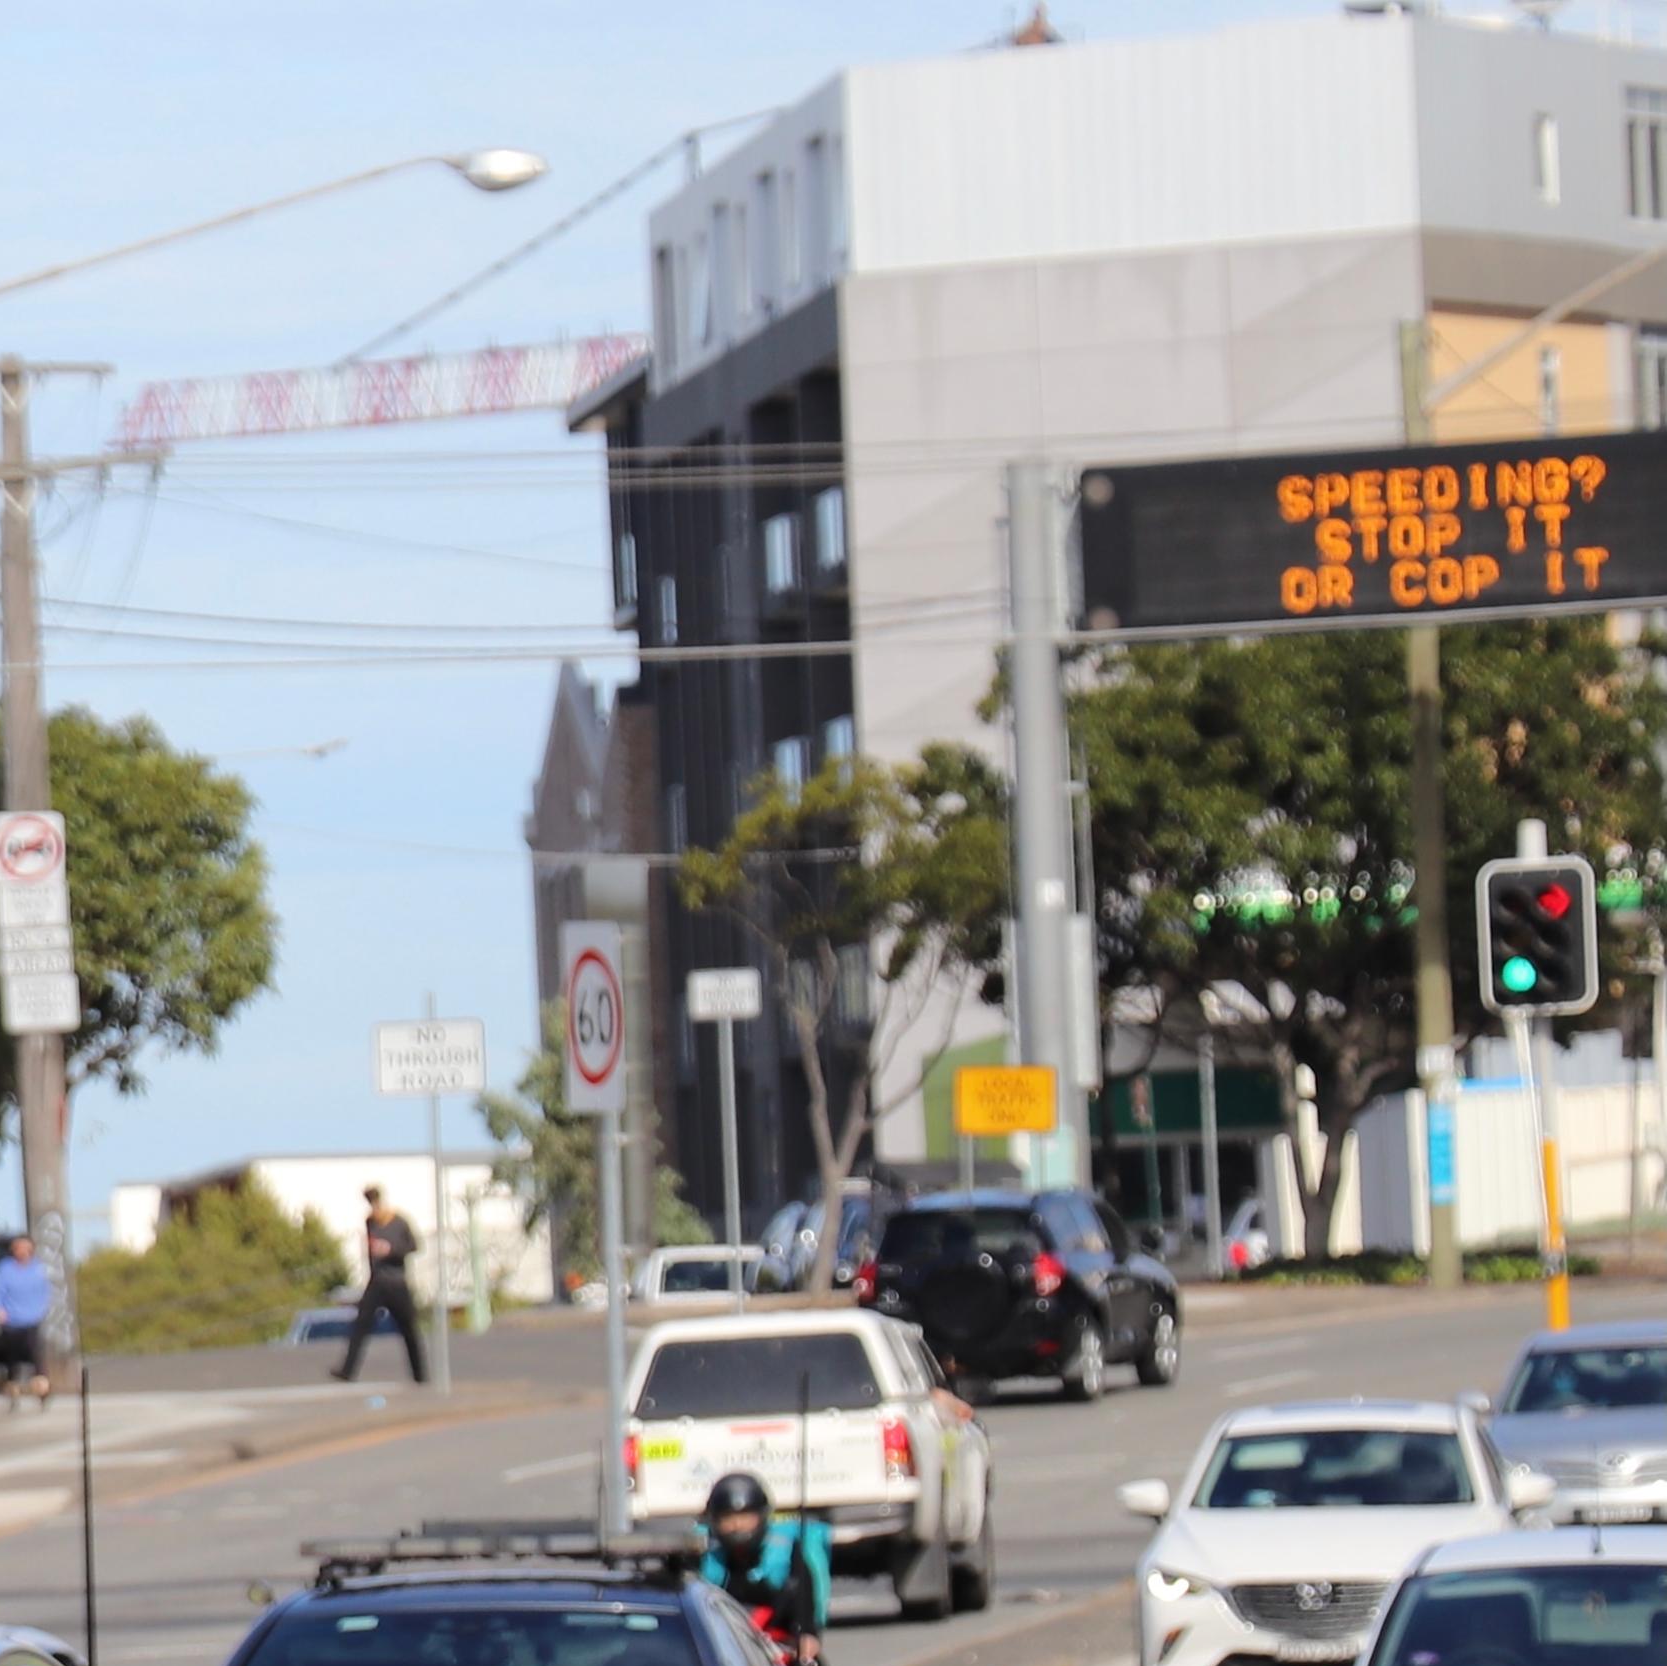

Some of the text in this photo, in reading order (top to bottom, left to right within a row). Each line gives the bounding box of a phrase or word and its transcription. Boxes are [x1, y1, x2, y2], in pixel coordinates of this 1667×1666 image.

[1277, 455, 1606, 523] SPEEDING?
[1315, 504, 1571, 562] STOP IT
[1280, 547, 1609, 613] OR COP IT
[416, 1026, 447, 1044] NO
[578, 988, 614, 1045] 60
[385, 1047, 480, 1068] THROUGH
[402, 1070, 465, 1091] ROAD
